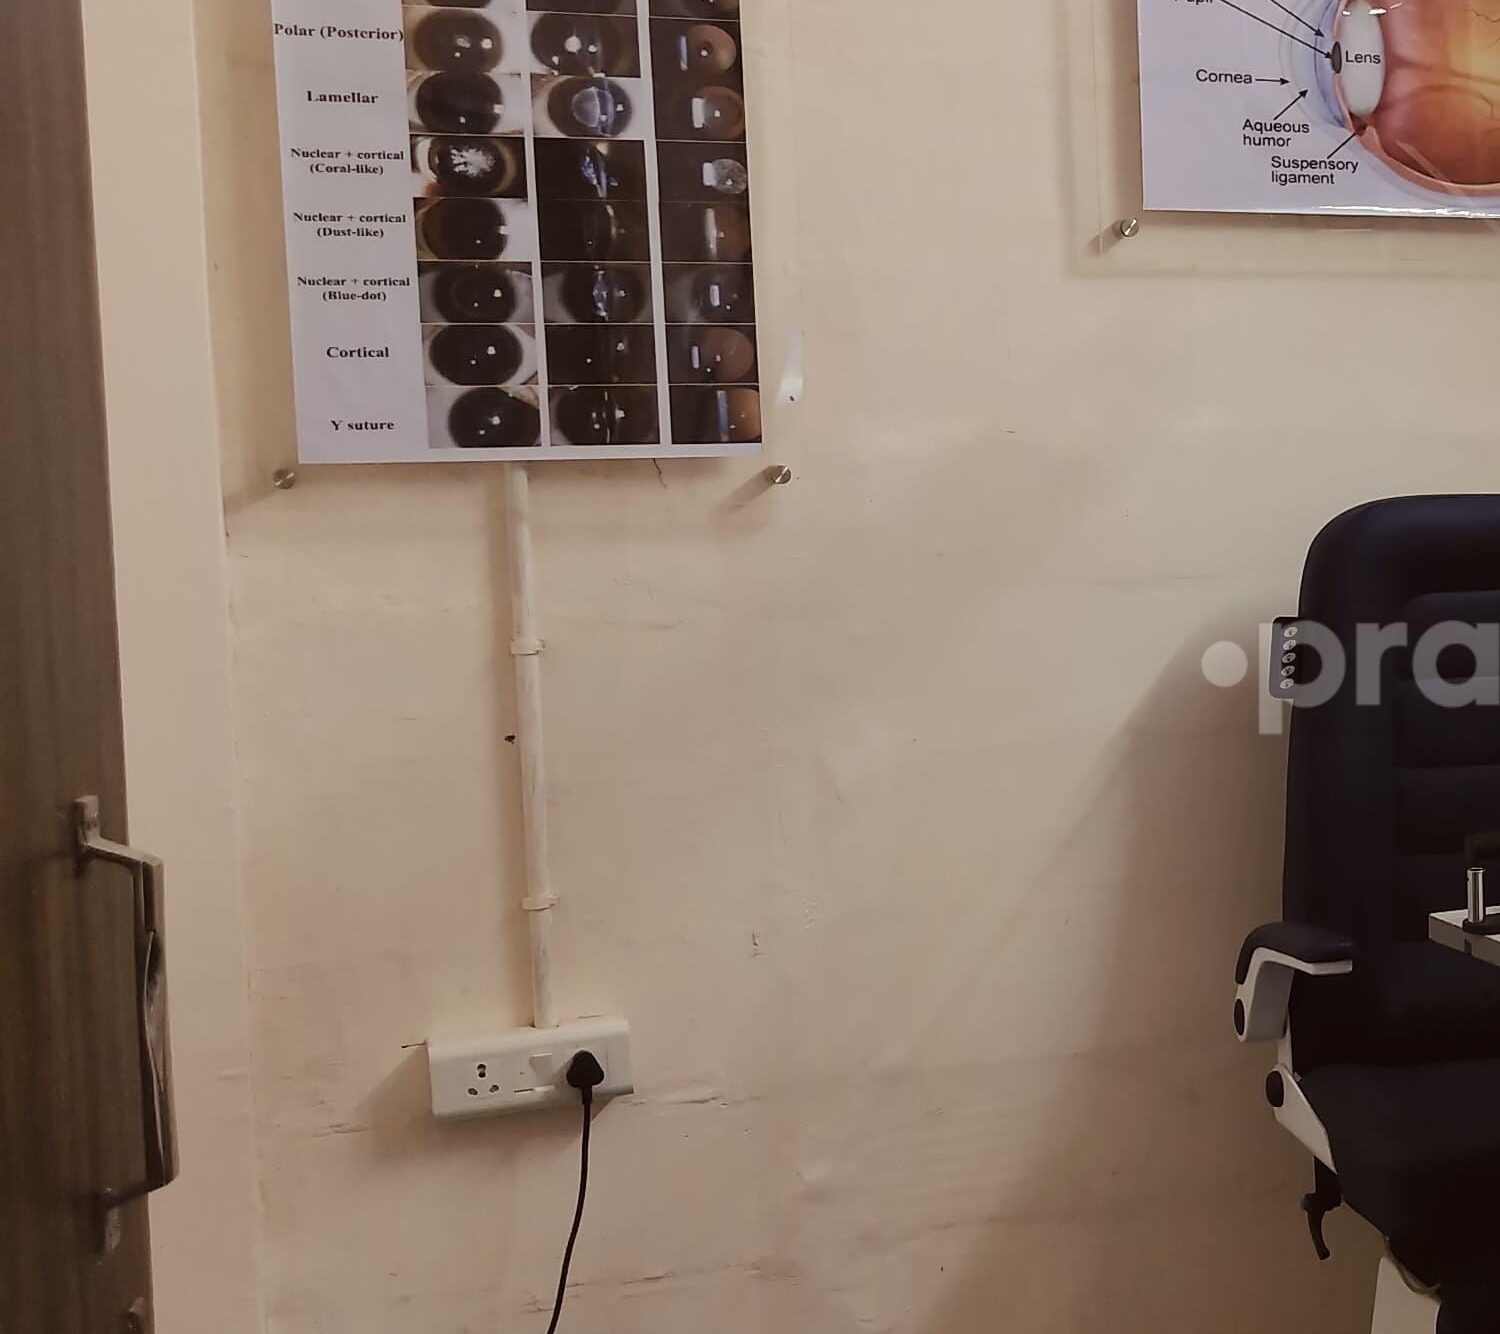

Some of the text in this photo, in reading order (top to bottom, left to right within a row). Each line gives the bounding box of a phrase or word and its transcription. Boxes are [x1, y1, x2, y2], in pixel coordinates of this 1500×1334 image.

[273, 24, 404, 43] Polar (Posterior)
[1345, 50, 1381, 65] Lens
[1196, 70, 1252, 85] Cornea
[306, 91, 378, 104] Lamellar
[1242, 119, 1309, 137] Aqueous
[1242, 134, 1292, 148] humor
[290, 148, 404, 161] Nuclear + cortical
[309, 162, 384, 176] (Coral-like)
[1270, 157, 1359, 175] Suspensory
[1271, 171, 1334, 187] ligament
[293, 212, 406, 224] Nuclear + cortical
[317, 226, 384, 239] (Dust-like)
[297, 275, 410, 287] Nuclear + cortical
[322, 289, 386, 302] (Blue-dot)
[326, 346, 389, 359] Cortical
[330, 419, 394, 431] Y suture
